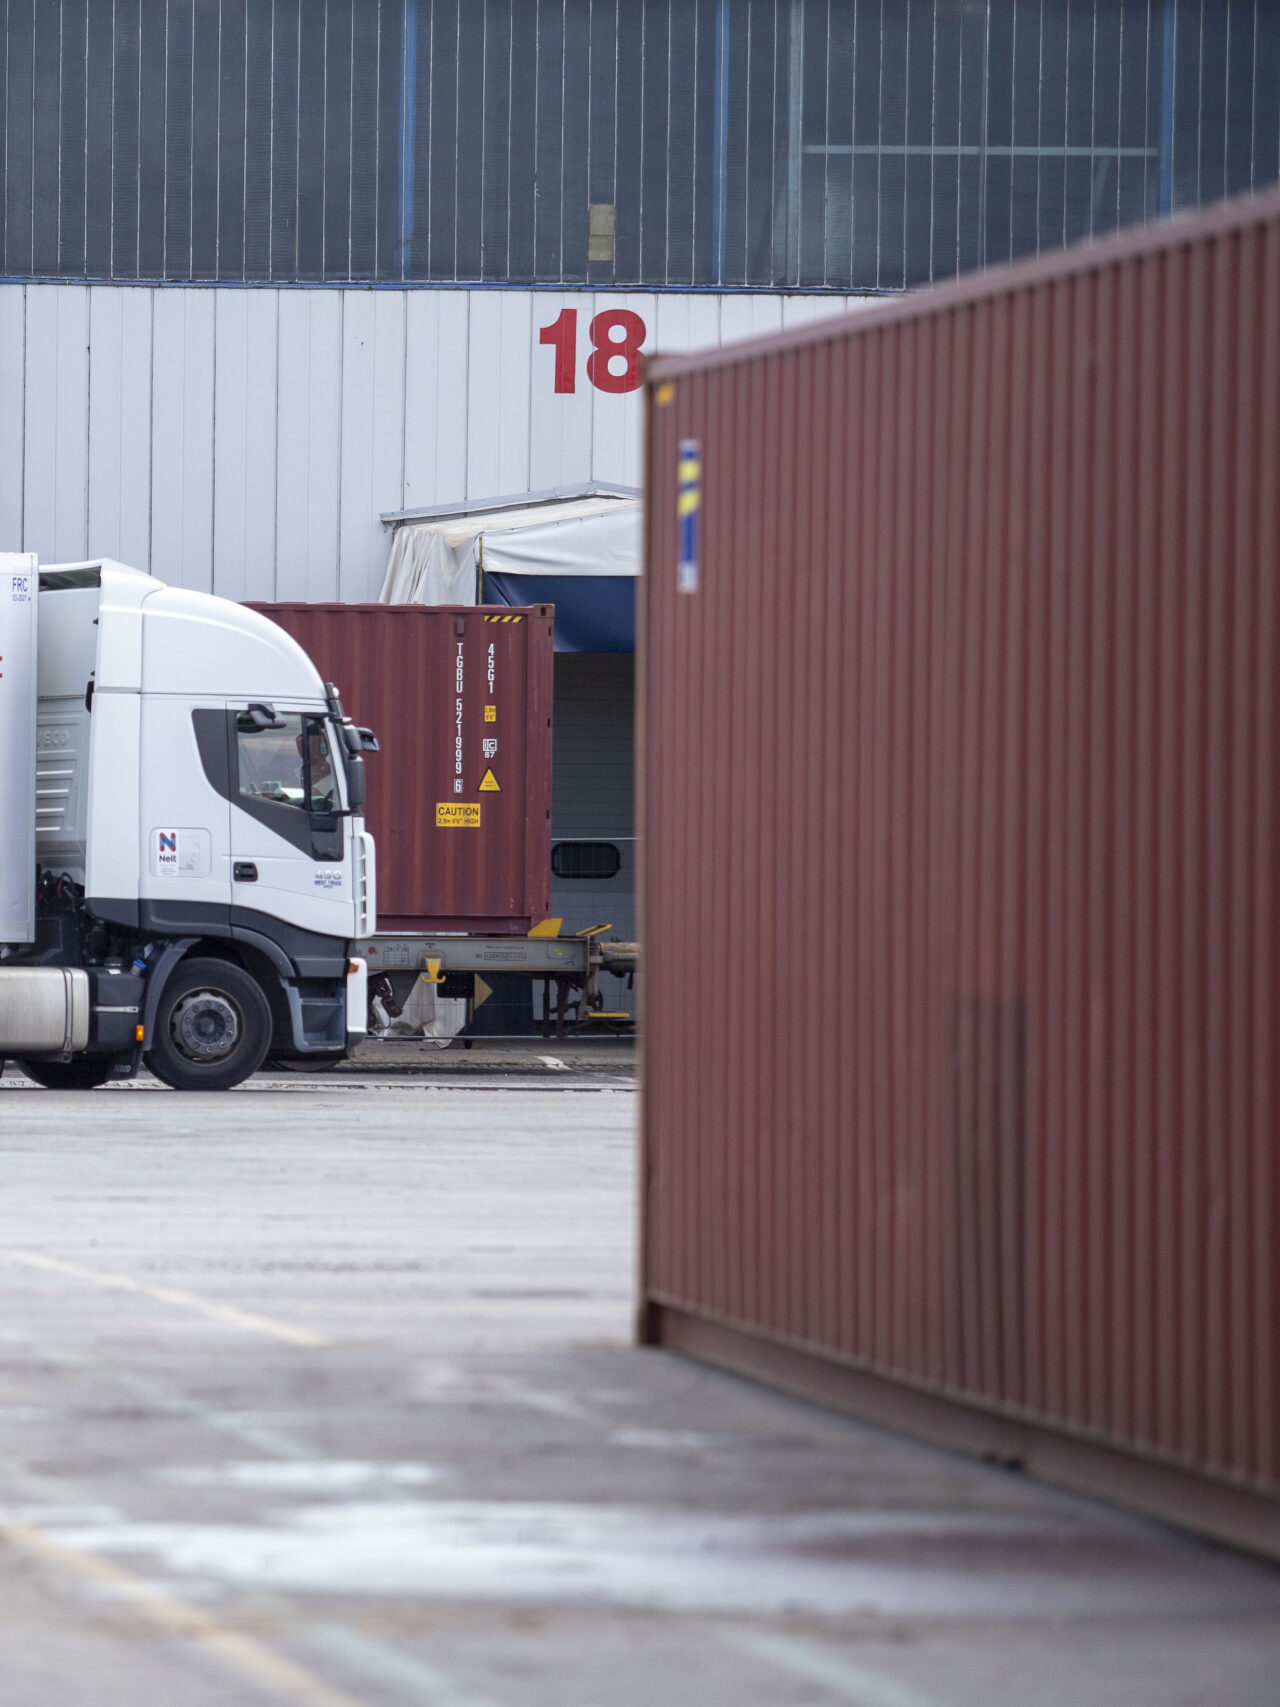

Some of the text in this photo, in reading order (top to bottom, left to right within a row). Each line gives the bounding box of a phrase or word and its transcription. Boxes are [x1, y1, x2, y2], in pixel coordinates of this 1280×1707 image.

[539, 307, 646, 395] 18
[12, 577, 28, 592] FRC
[455, 642, 464, 693] TGBU
[487, 643, 495, 694] 45G1
[455, 698, 463, 774] 521999
[438, 807, 479, 816] CAUTION
[159, 855, 177, 863] Nelt
